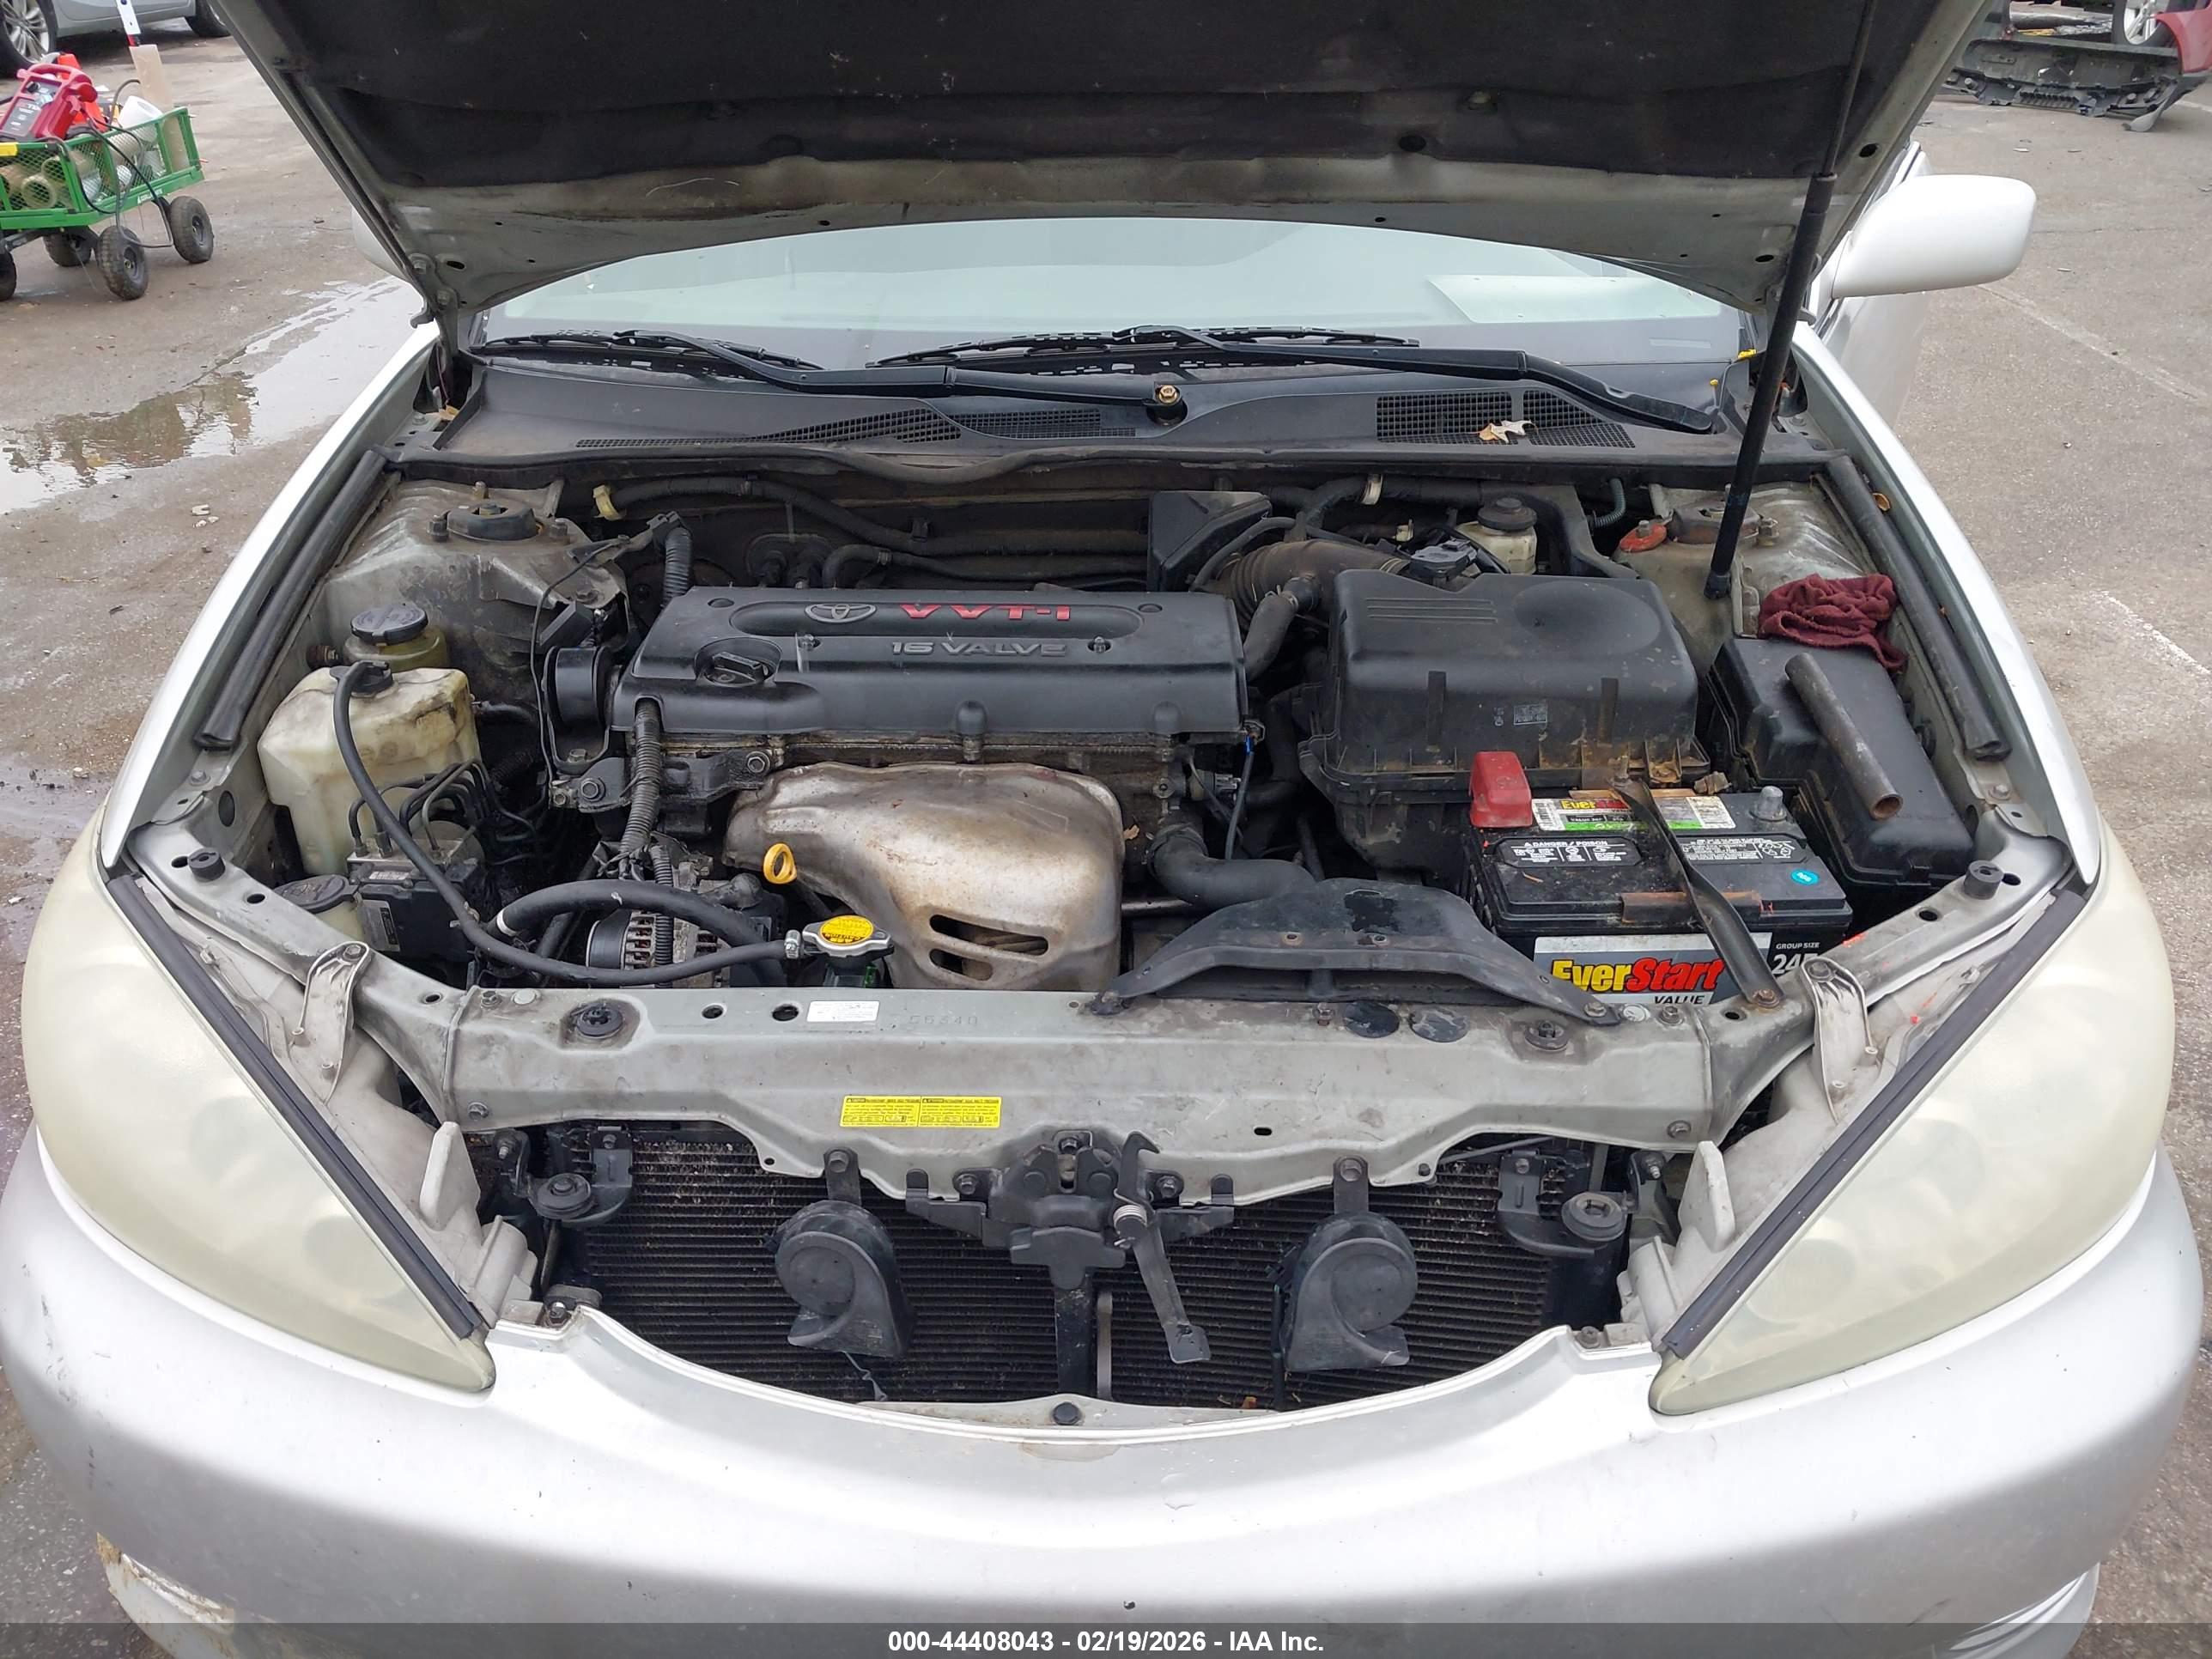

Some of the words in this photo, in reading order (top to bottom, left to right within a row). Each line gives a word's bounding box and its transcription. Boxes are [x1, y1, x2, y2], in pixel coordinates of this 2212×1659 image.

[892, 641, 934, 655] 16
[942, 642, 1066, 657] VALVE
[1552, 957, 1725, 994] EverStart
[1654, 995, 1705, 1005] VALUE
